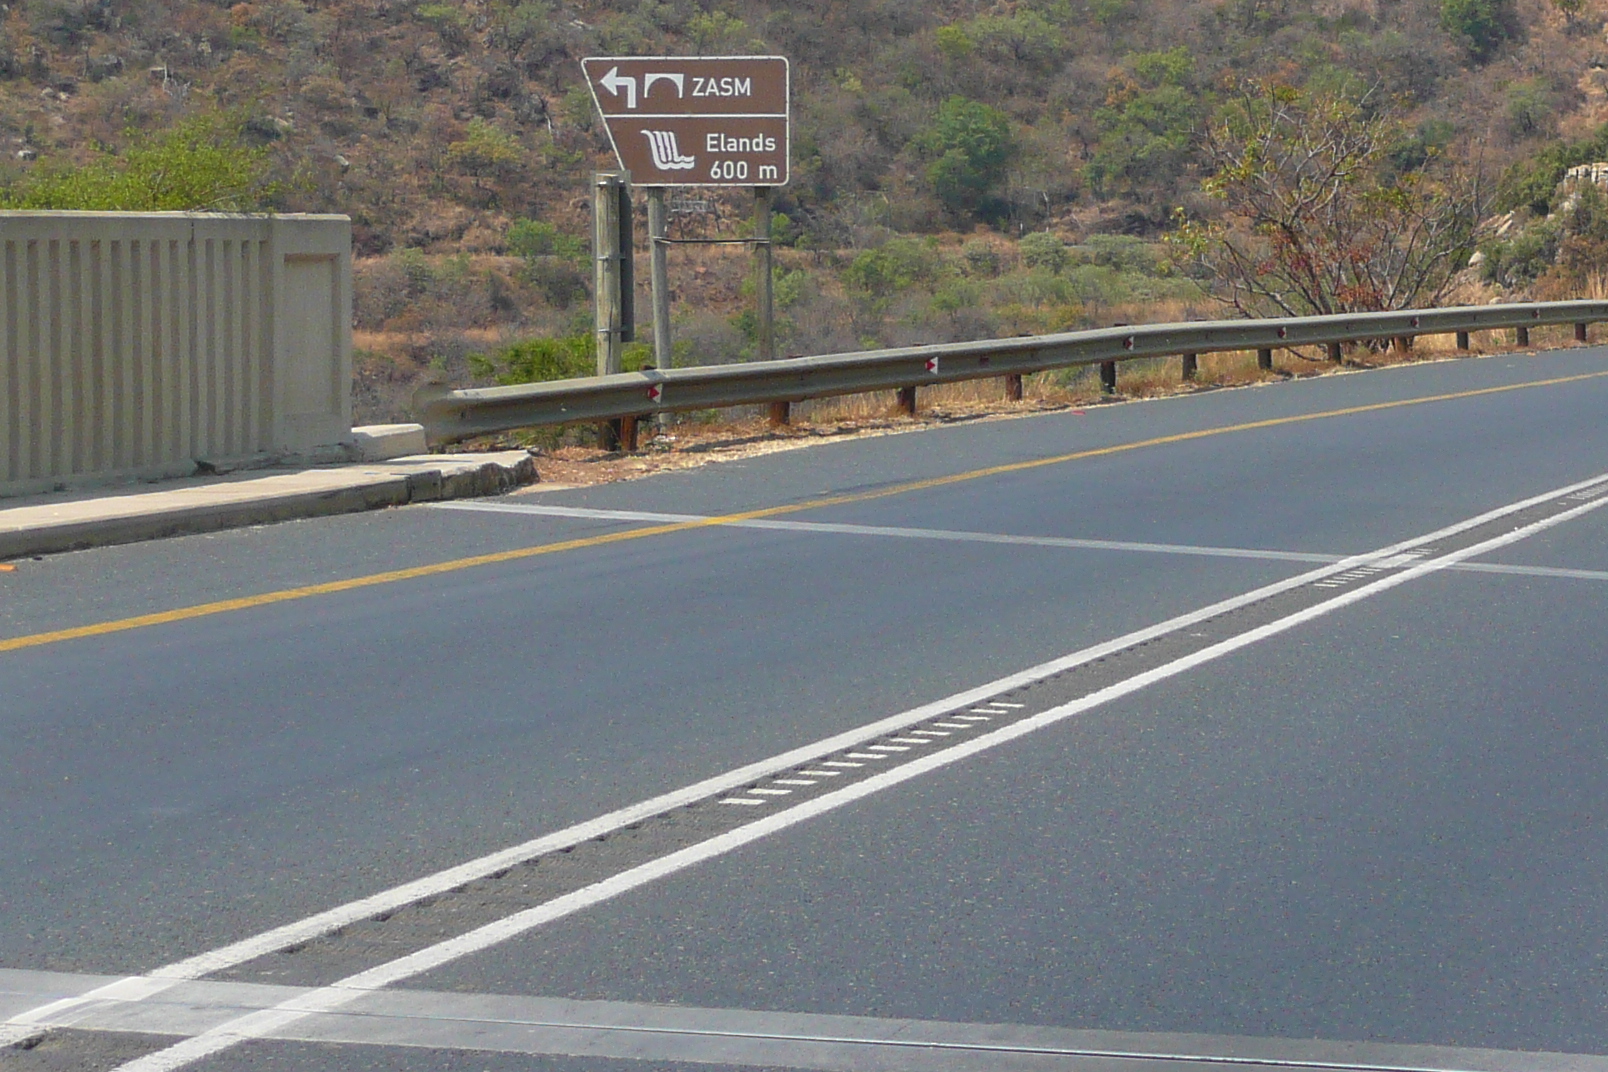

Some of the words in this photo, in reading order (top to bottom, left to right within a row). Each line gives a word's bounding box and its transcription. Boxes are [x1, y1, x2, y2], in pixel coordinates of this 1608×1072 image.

[692, 77, 751, 96] ZASM
[706, 133, 776, 152] Elands
[710, 161, 748, 179] 600
[759, 165, 777, 179] m
